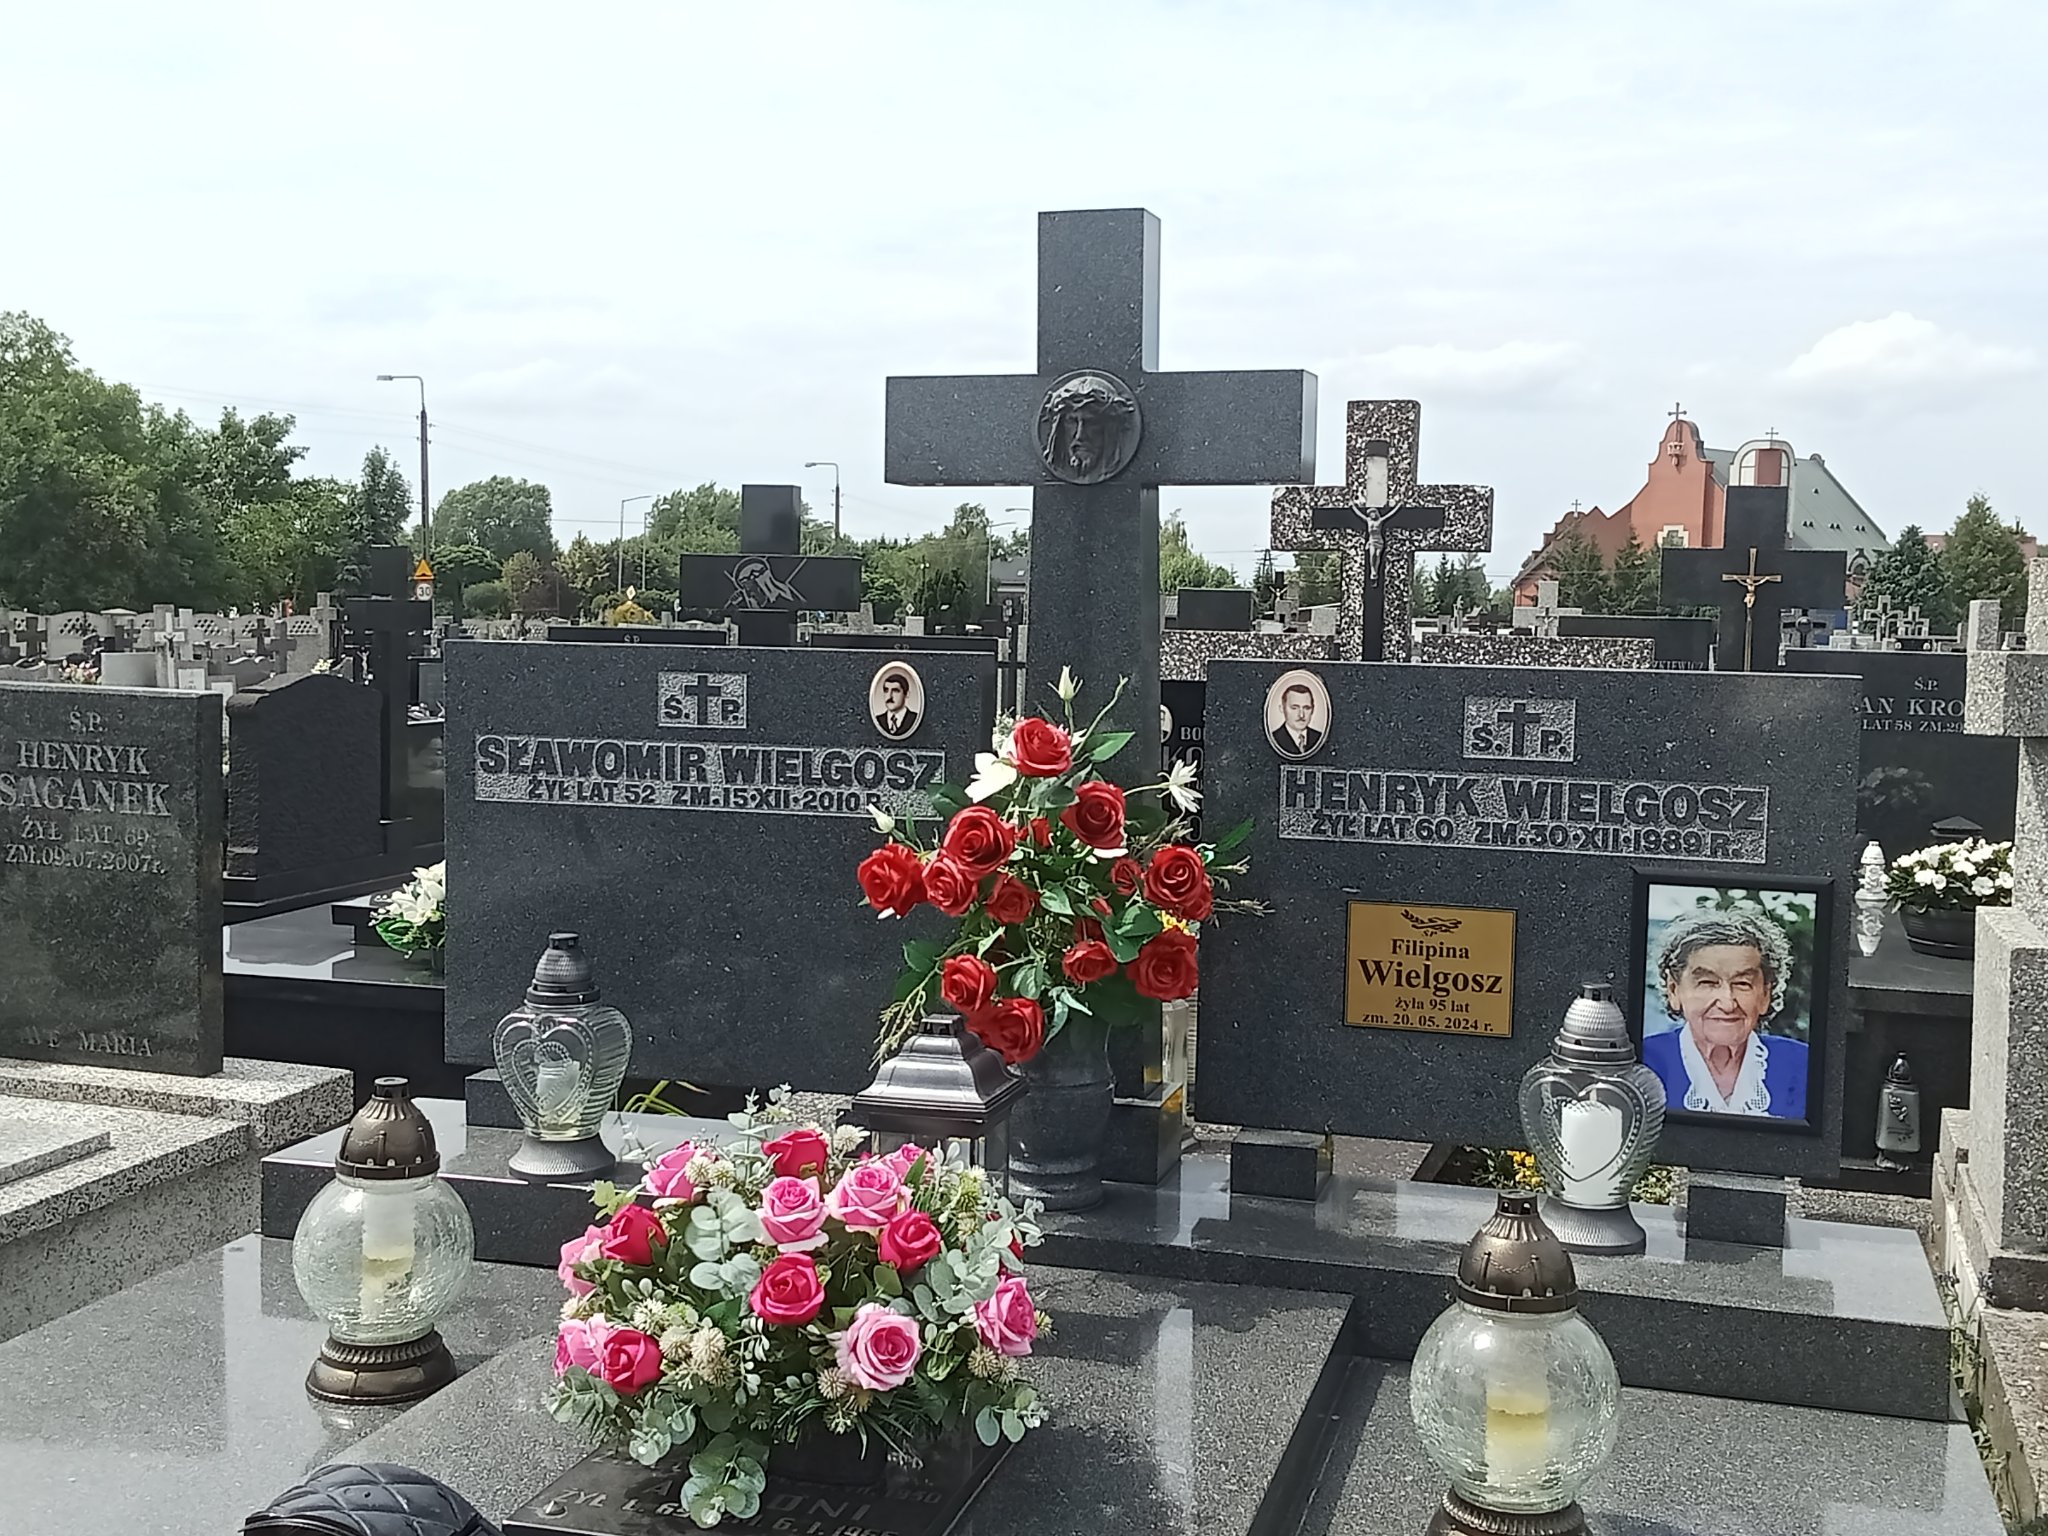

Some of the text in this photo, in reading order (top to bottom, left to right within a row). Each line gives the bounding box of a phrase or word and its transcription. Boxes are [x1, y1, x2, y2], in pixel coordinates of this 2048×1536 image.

[419, 586, 431, 597] 30
[1908, 698, 1965, 717] KRO
[1862, 719, 1893, 731] LAT
[1895, 720, 1912, 731] 58
[17, 740, 150, 775] HENRYK
[477, 736, 942, 791] SŁAWOMIR WIELGOSZ
[0, 772, 171, 817] SAGANEK
[577, 780, 619, 803] LAT
[624, 783, 656, 805] 52
[1285, 768, 1765, 832] HENRYK WIELGOSZ
[1363, 815, 1413, 840] LAT
[1415, 817, 1453, 842] 60
[1392, 938, 1470, 961] Filipina
[1358, 958, 1503, 998] Wielgosz
[1429, 998, 1447, 1012] 95
[1451, 1000, 1470, 1014] lat
[1444, 1017, 1479, 1031] 2024
[78, 1029, 153, 1057] MARIA
